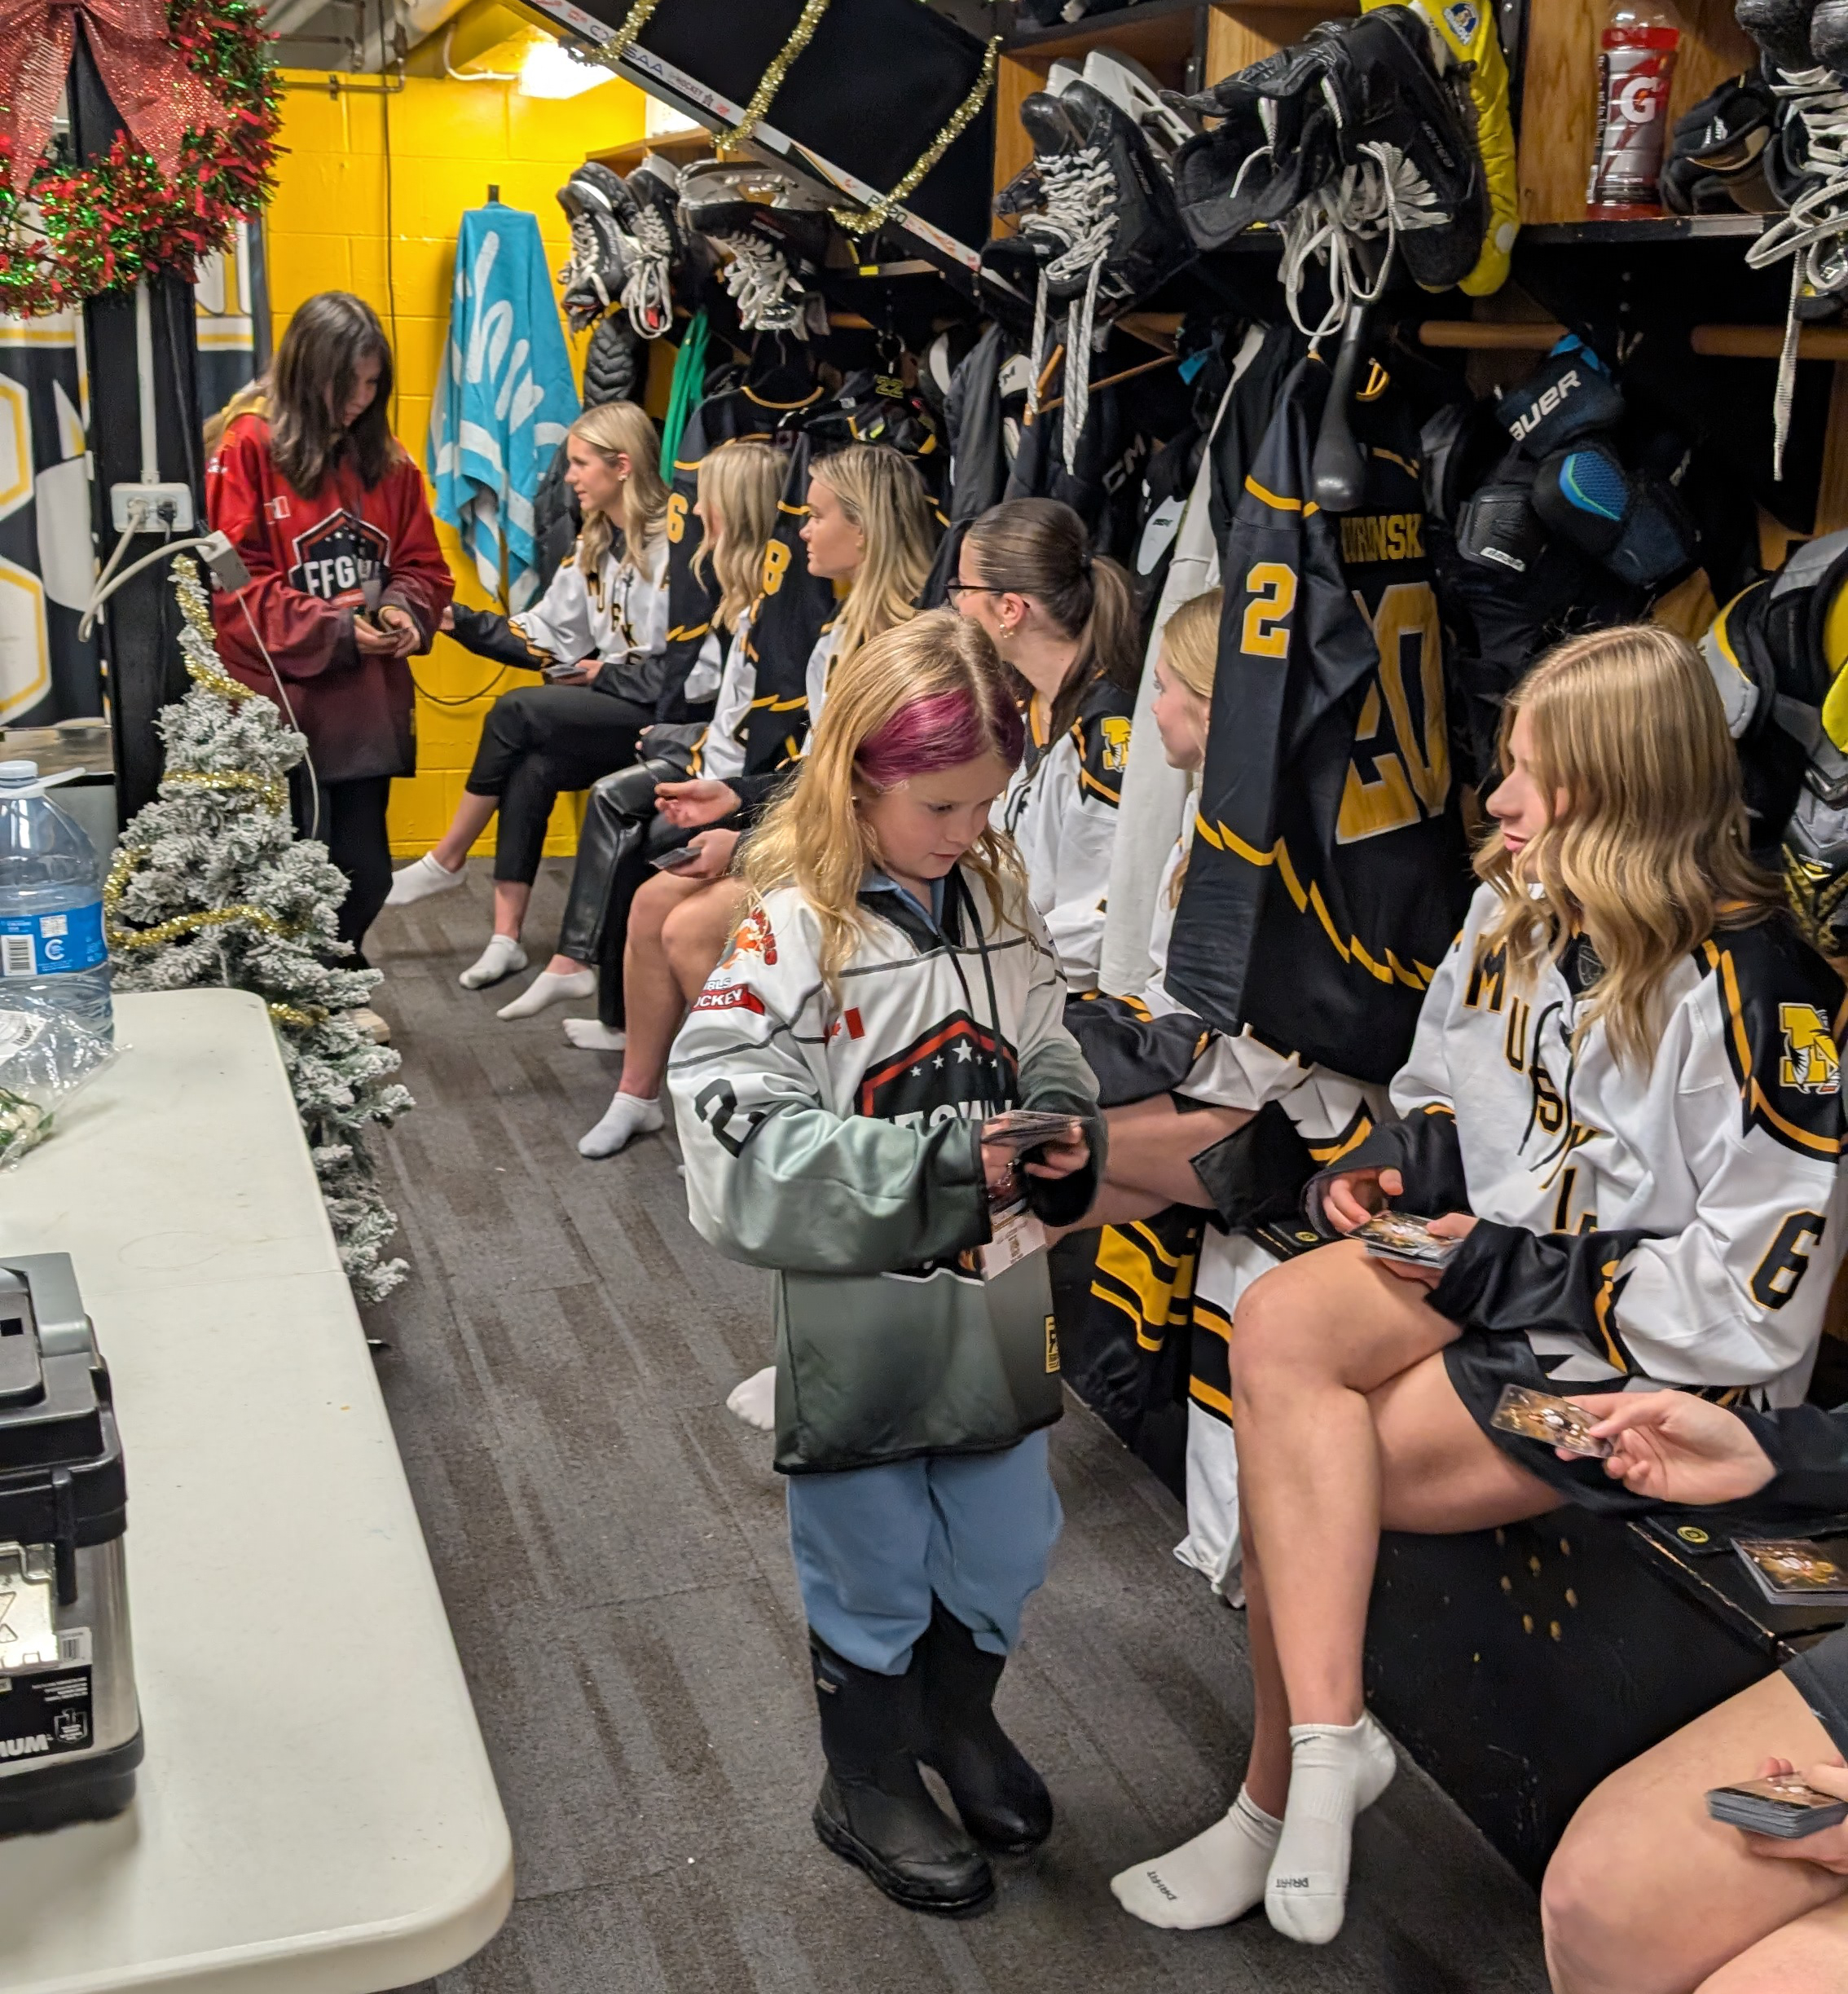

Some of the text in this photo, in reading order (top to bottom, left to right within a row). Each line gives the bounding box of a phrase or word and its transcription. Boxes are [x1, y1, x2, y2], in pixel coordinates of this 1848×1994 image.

[1620, 77, 1659, 124] G
[1239, 561, 1297, 659] 2
[1747, 1208, 1828, 1313] 6
[0, 1733, 50, 1758] UM
